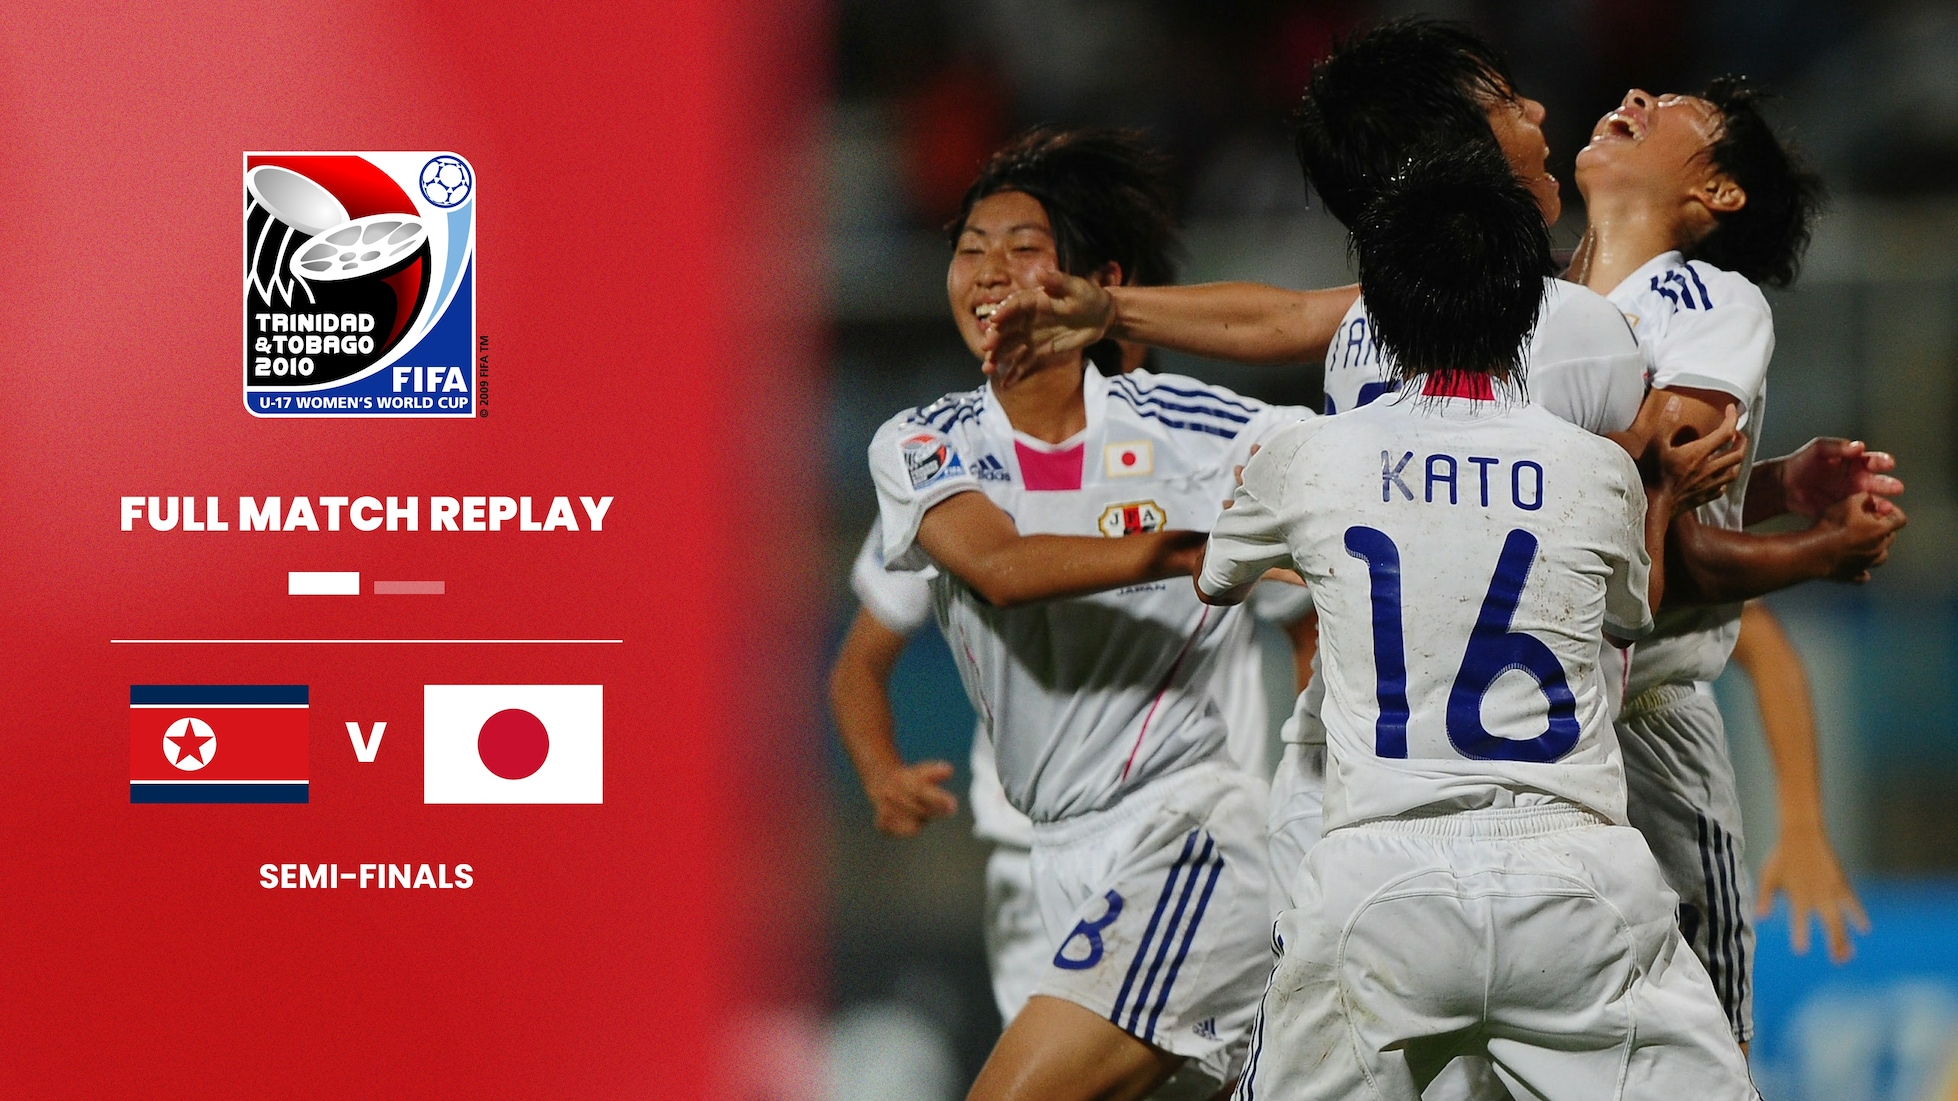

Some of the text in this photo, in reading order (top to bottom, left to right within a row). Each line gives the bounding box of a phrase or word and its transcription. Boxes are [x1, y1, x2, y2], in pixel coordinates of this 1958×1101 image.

[1380, 449, 1544, 511] KATO
[1110, 508, 1155, 526] JFA
[1343, 525, 1581, 765] 16
